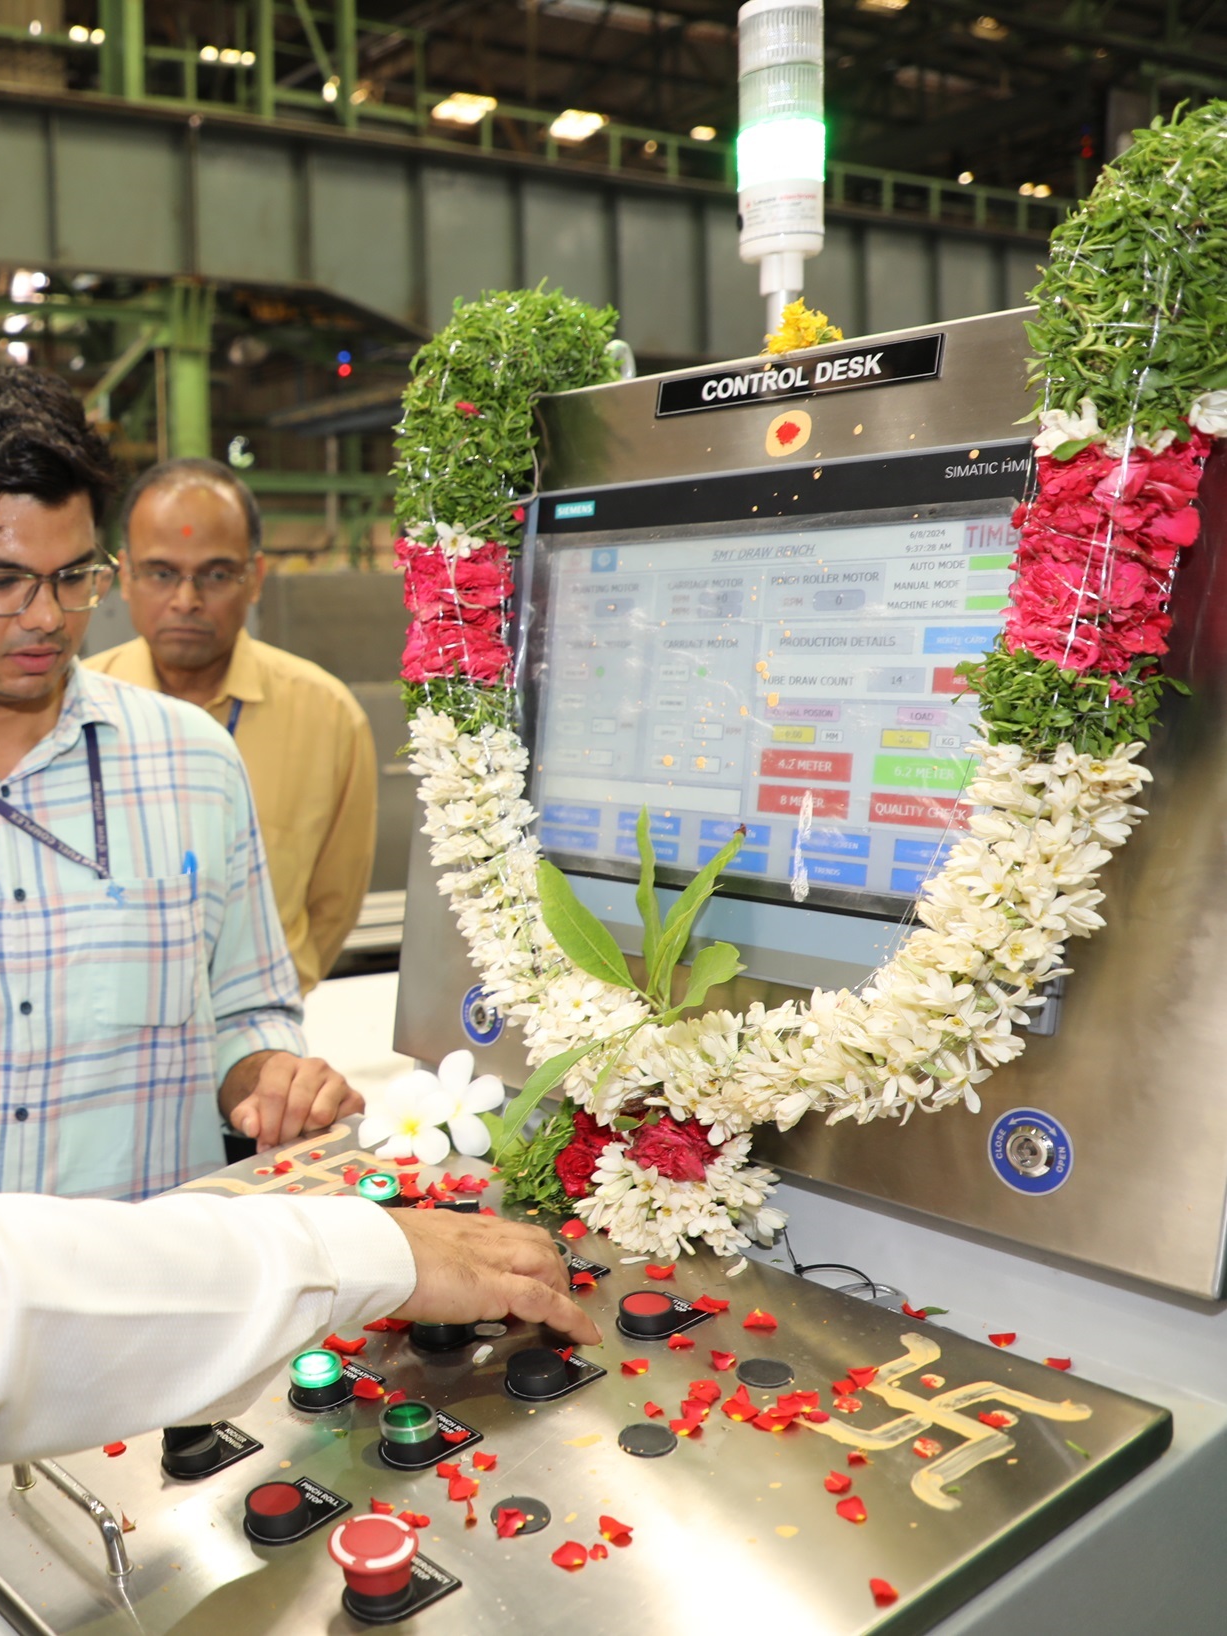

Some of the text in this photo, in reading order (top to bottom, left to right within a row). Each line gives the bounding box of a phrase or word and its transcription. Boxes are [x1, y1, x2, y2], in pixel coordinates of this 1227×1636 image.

[701, 352, 884, 401] CONTROL DESK
[944, 459, 1030, 479] SIMATIC HMI
[557, 503, 593, 515] SIEMENS
[910, 529, 946, 539] 6/8/2024
[738, 547, 774, 560] DRAW
[775, 544, 817, 558] BENCH
[905, 543, 952, 553] 9:37:28 AM
[909, 560, 966, 571] AUTO MODE
[712, 578, 744, 589] MOTOR
[771, 572, 880, 586] PINCH ROLLER MOTOR
[893, 580, 961, 590] MANUAL MODE
[611, 583, 639, 593] MOTOR
[835, 595, 843, 606] 0
[887, 600, 959, 610] MACHINE HOME
[707, 638, 739, 649] MOTOR
[779, 636, 896, 648] PRODUCTION DETAILS
[763, 675, 854, 686] TUBE DRAW COUNT
[892, 676, 903, 685] 14
[803, 709, 834, 718] POSION
[911, 713, 935, 721] LOAD
[825, 732, 840, 740] MM
[941, 738, 955, 746] KG
[778, 759, 833, 772] 4.2 METER
[894, 766, 955, 779] 6.2 METER
[780, 795, 825, 808] 8 MEER
[875, 803, 967, 821] QUALITY CHECK
[10, 811, 57, 845] COMPLEX
[994, 1128, 1007, 1160] CLOSE
[1055, 1146, 1067, 1173] OPEN
[437, 1414, 457, 1428] PINCH
[301, 1481, 339, 1507] PINCH ROLL
[305, 1492, 324, 1504] STOP
